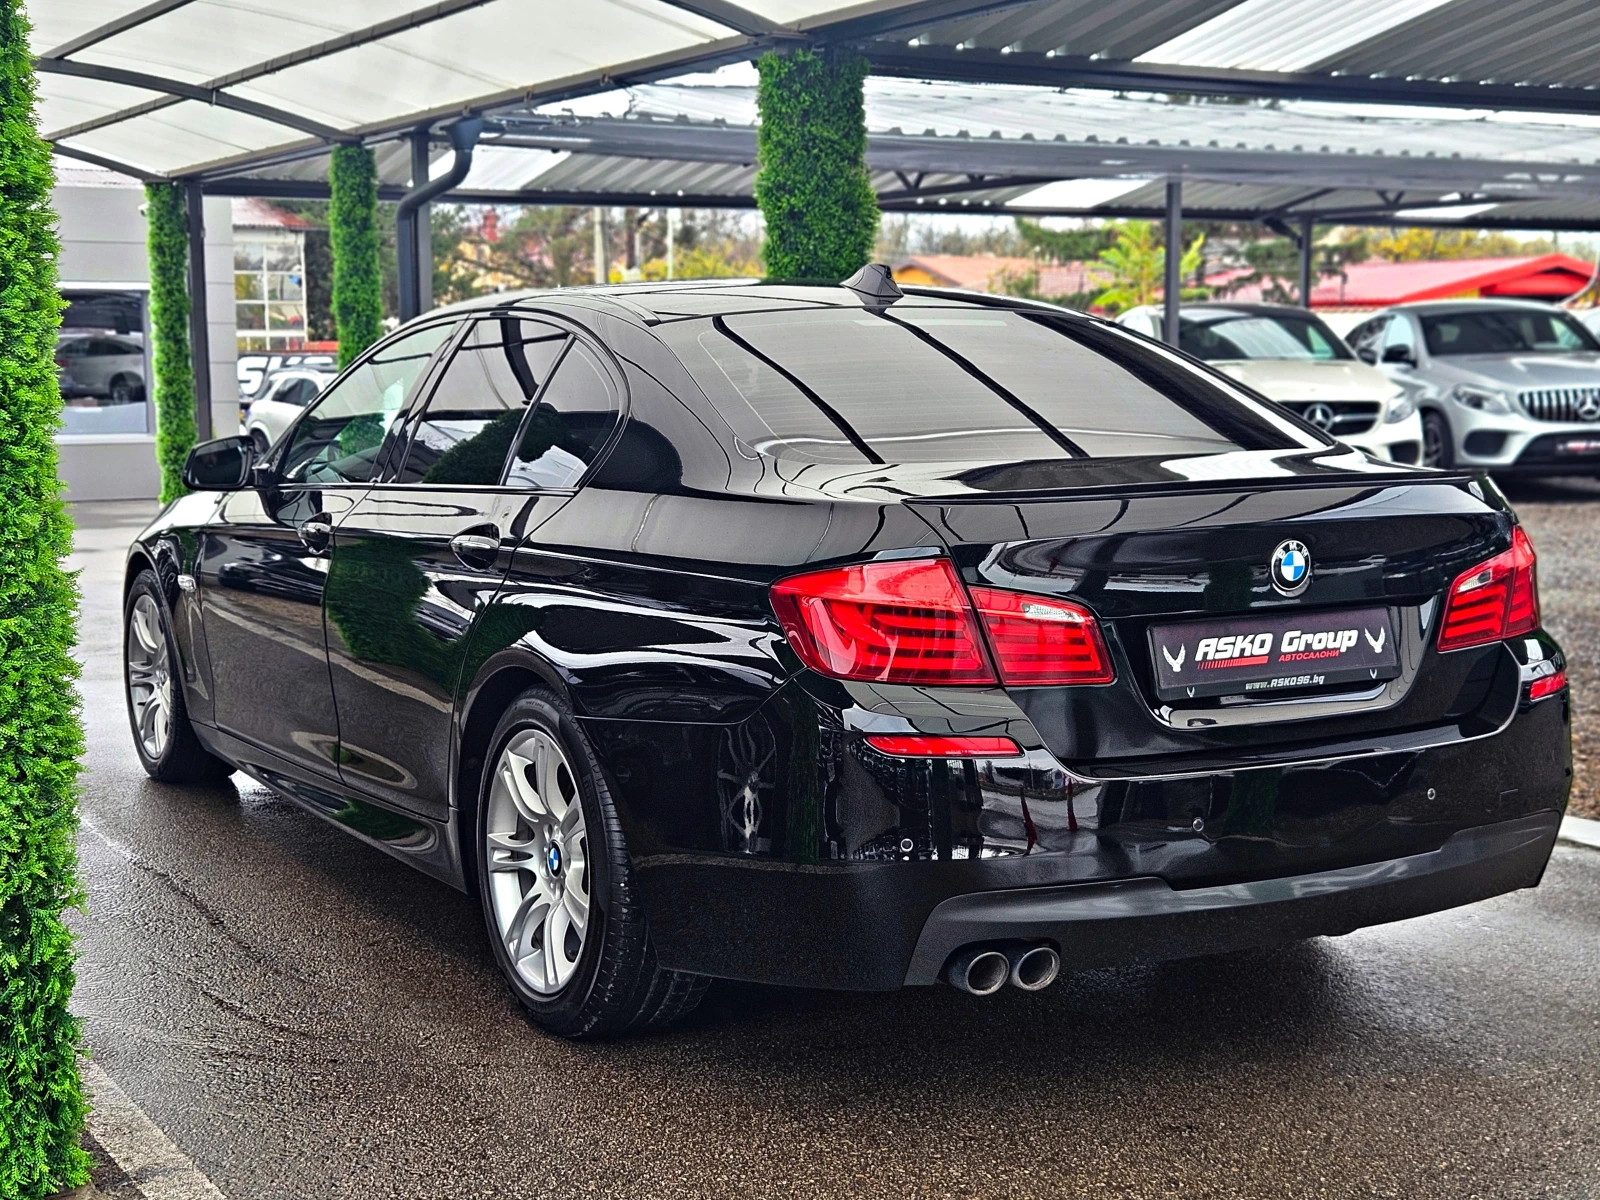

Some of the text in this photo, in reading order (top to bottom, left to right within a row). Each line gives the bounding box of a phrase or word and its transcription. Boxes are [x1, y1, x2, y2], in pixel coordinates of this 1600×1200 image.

[1194, 629, 1359, 662] ASKO Group
[1278, 649, 1340, 663] АВТОСАЛОНИ
[1245, 674, 1325, 690] www.ASKO96.bg
